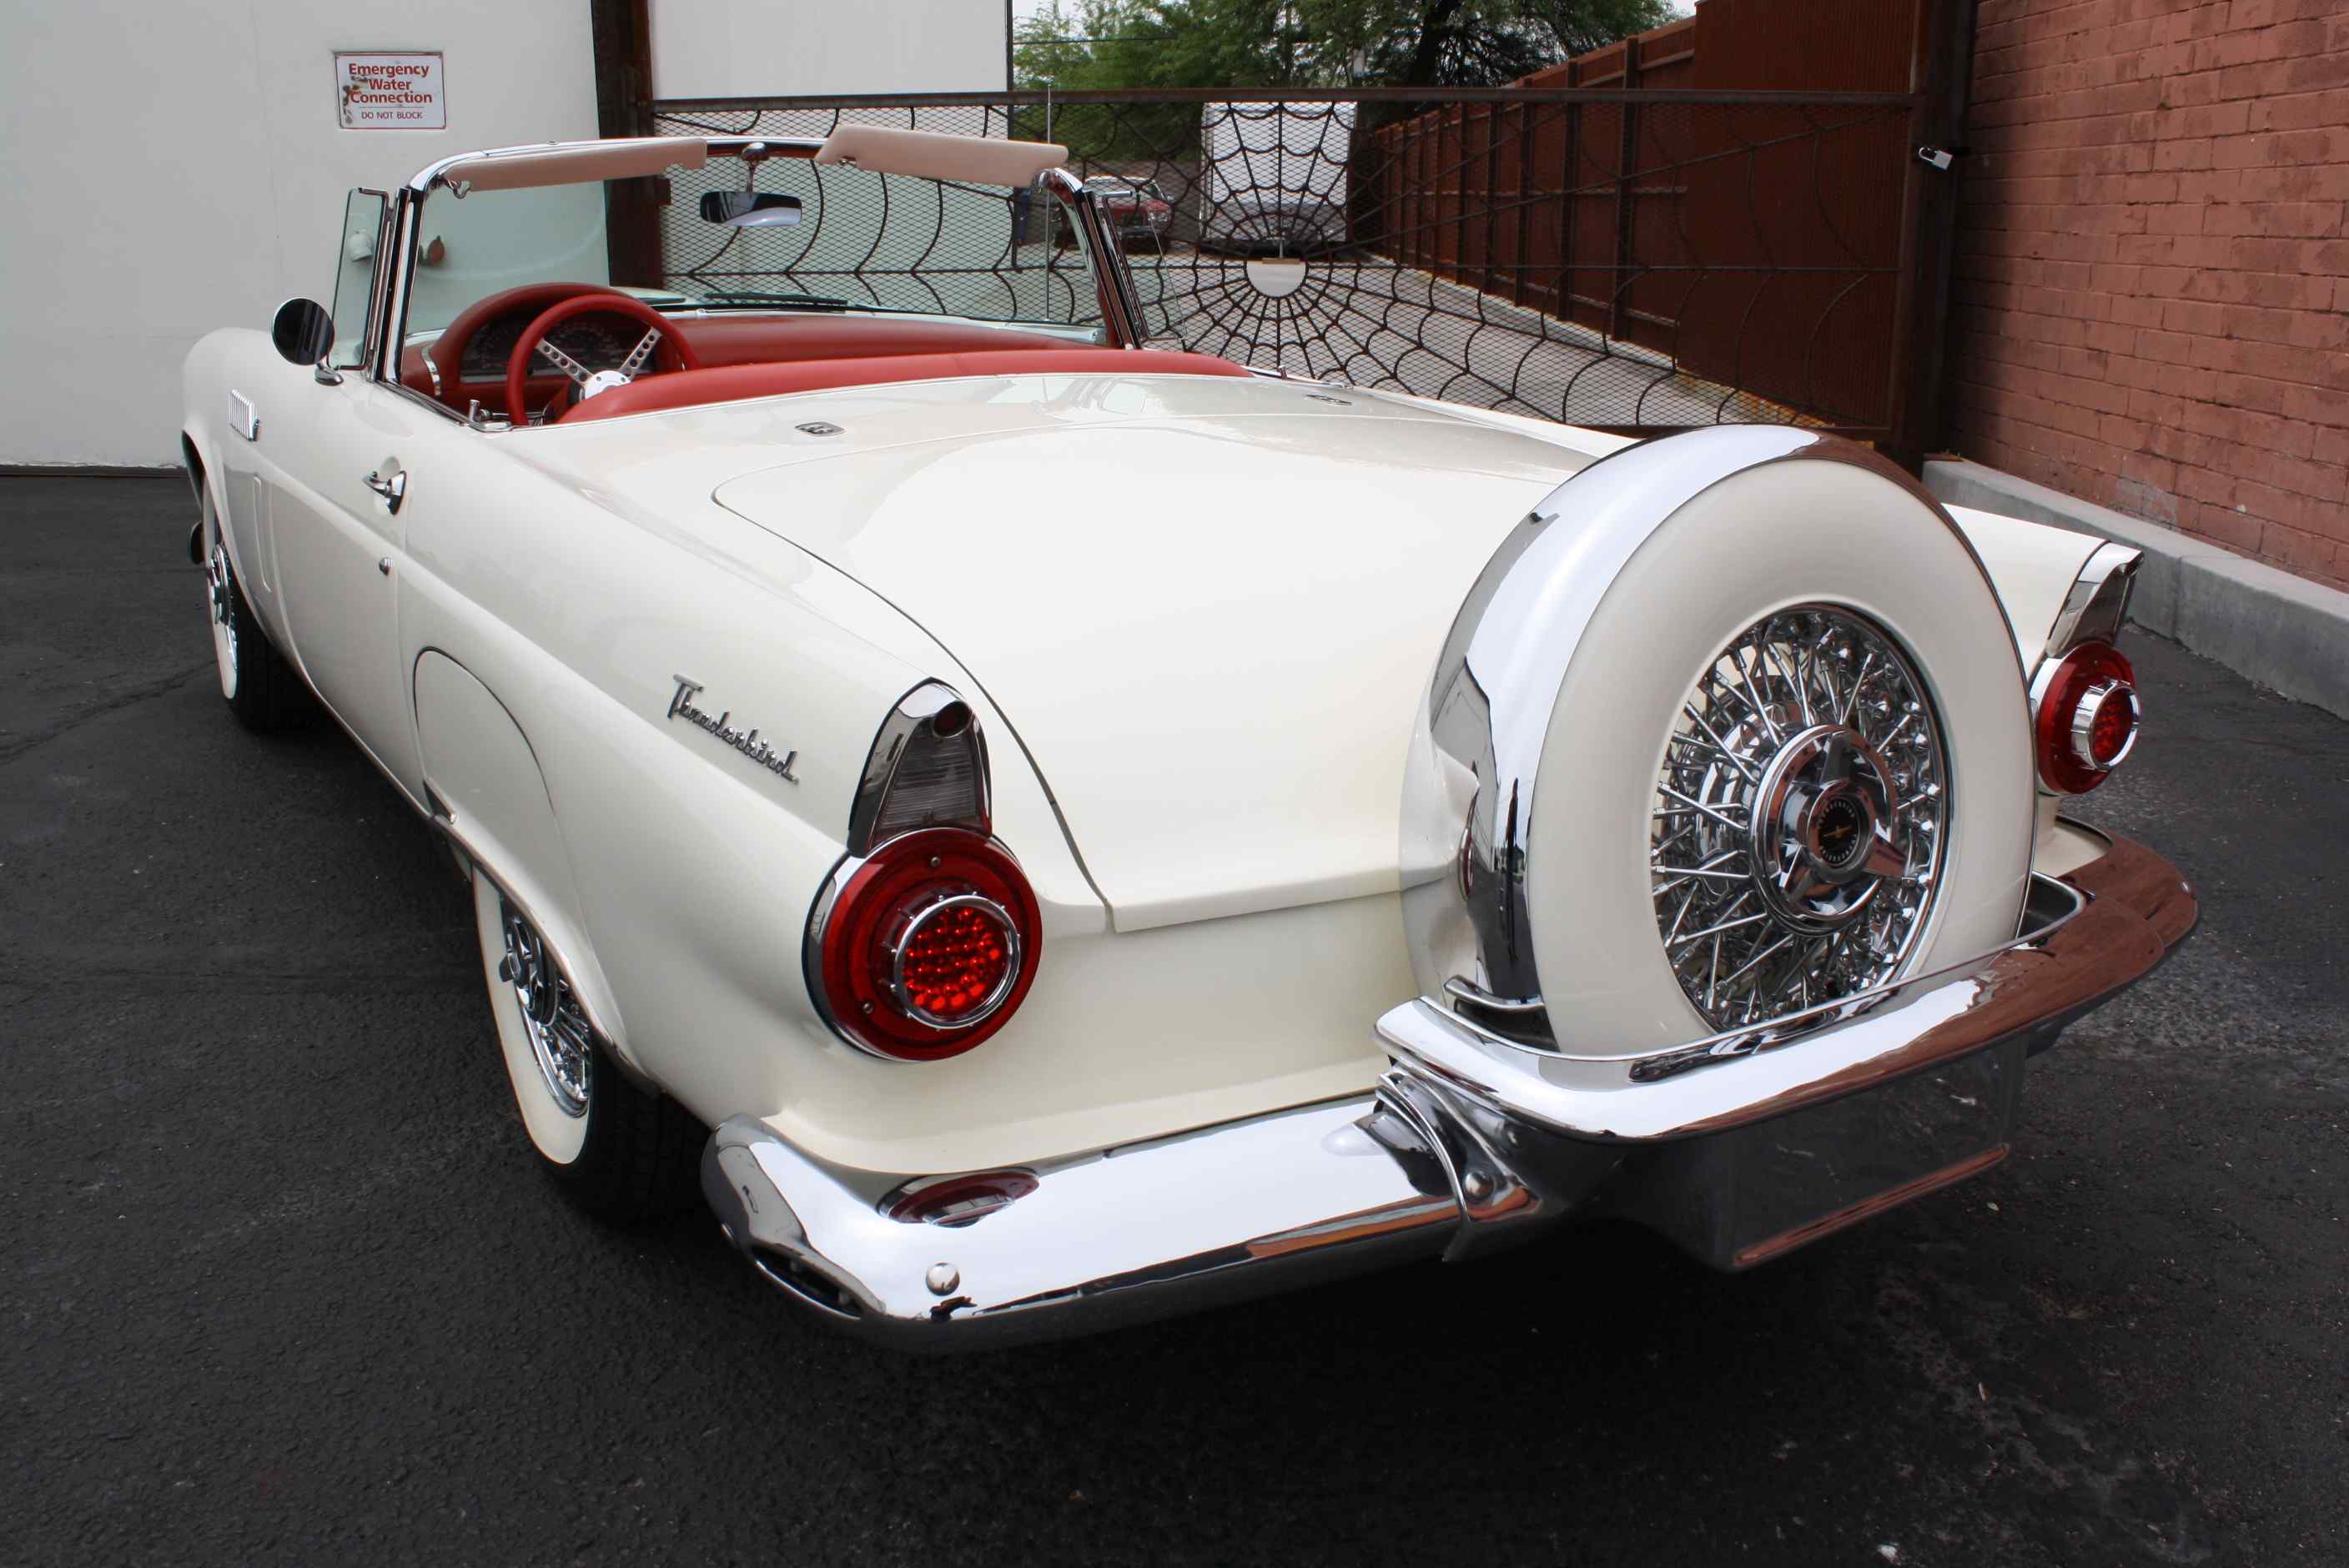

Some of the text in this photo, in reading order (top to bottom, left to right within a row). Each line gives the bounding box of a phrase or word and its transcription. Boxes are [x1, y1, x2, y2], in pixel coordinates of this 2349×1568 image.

[349, 63, 430, 78] Emergency
[368, 78, 412, 90] Water
[350, 91, 433, 103] Connection
[667, 674, 799, 786] Thunderbird
